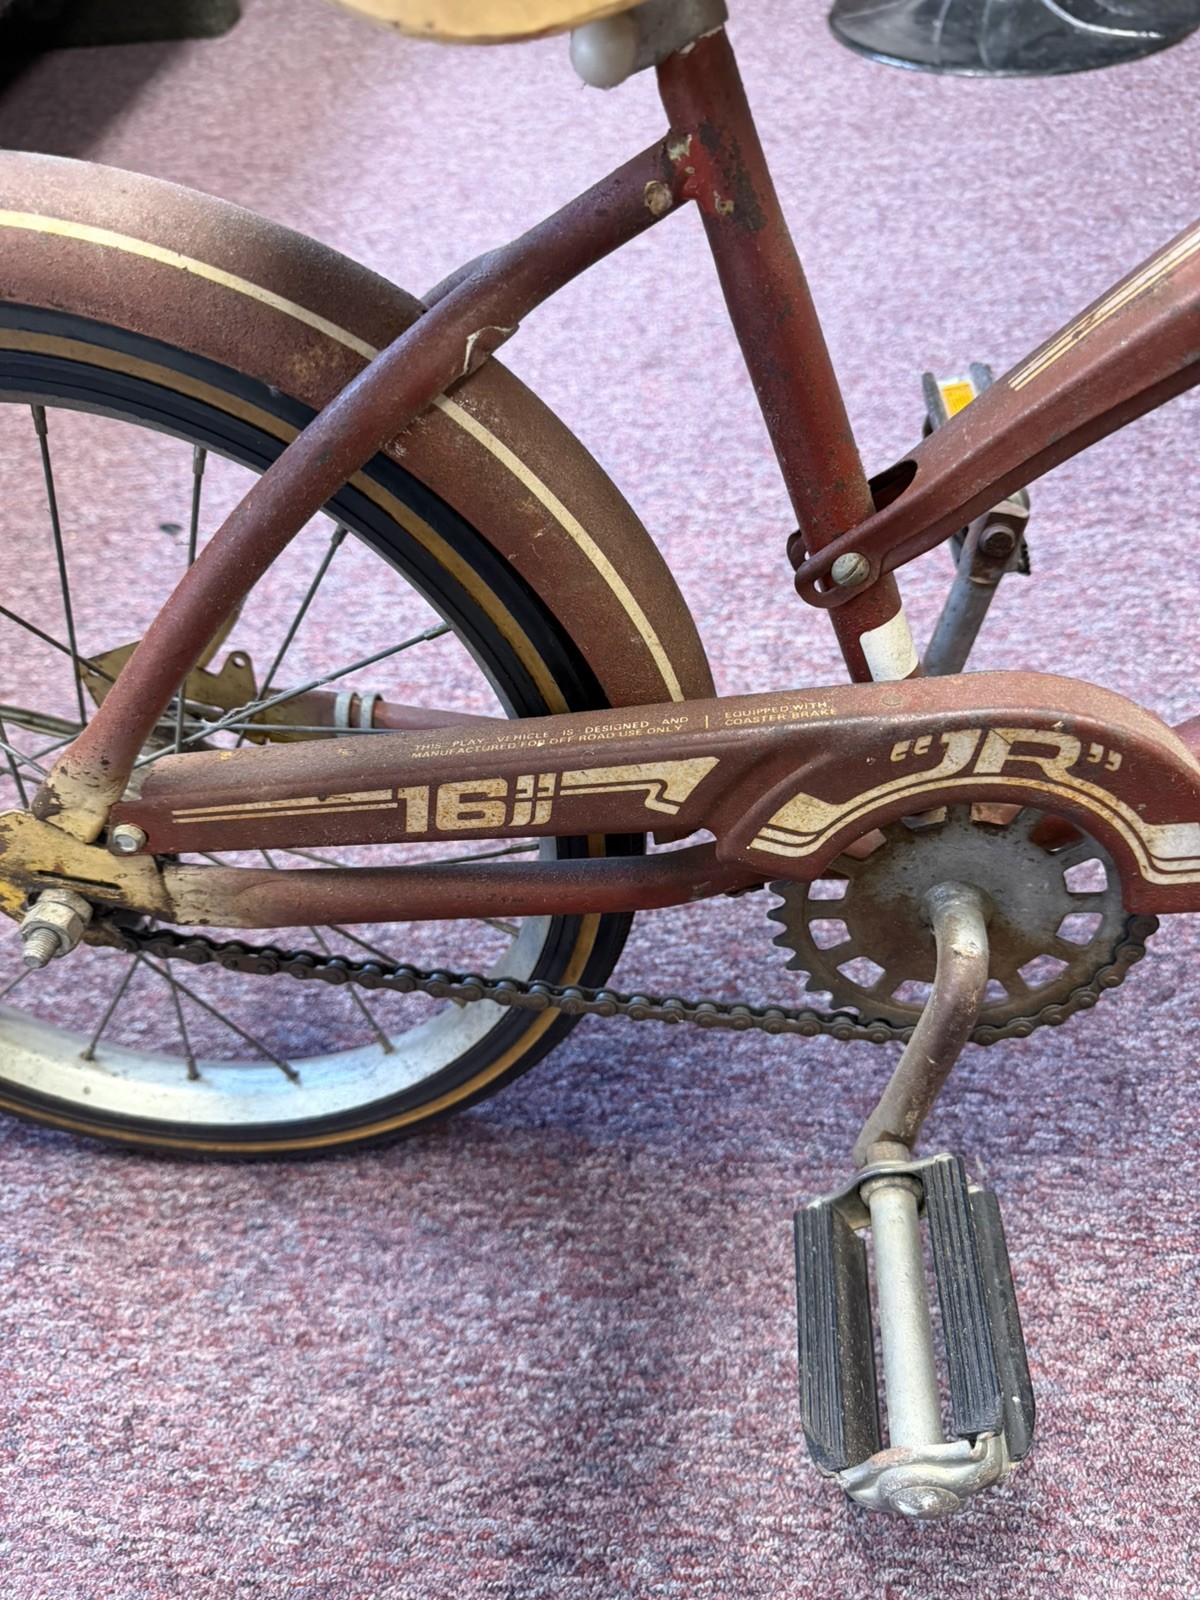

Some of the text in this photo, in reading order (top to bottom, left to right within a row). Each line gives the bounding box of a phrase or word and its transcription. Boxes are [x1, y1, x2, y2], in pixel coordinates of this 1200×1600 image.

[725, 701, 827, 719] EQUIPPED WITH
[725, 708, 838, 726] COASTER BRAKE
[411, 725, 683, 759] MANUFACTURED FOR OFF ROAD USE ONLY
[414, 716, 689, 751] THIS PLAY VEHICLE IS DESIGNED AND
